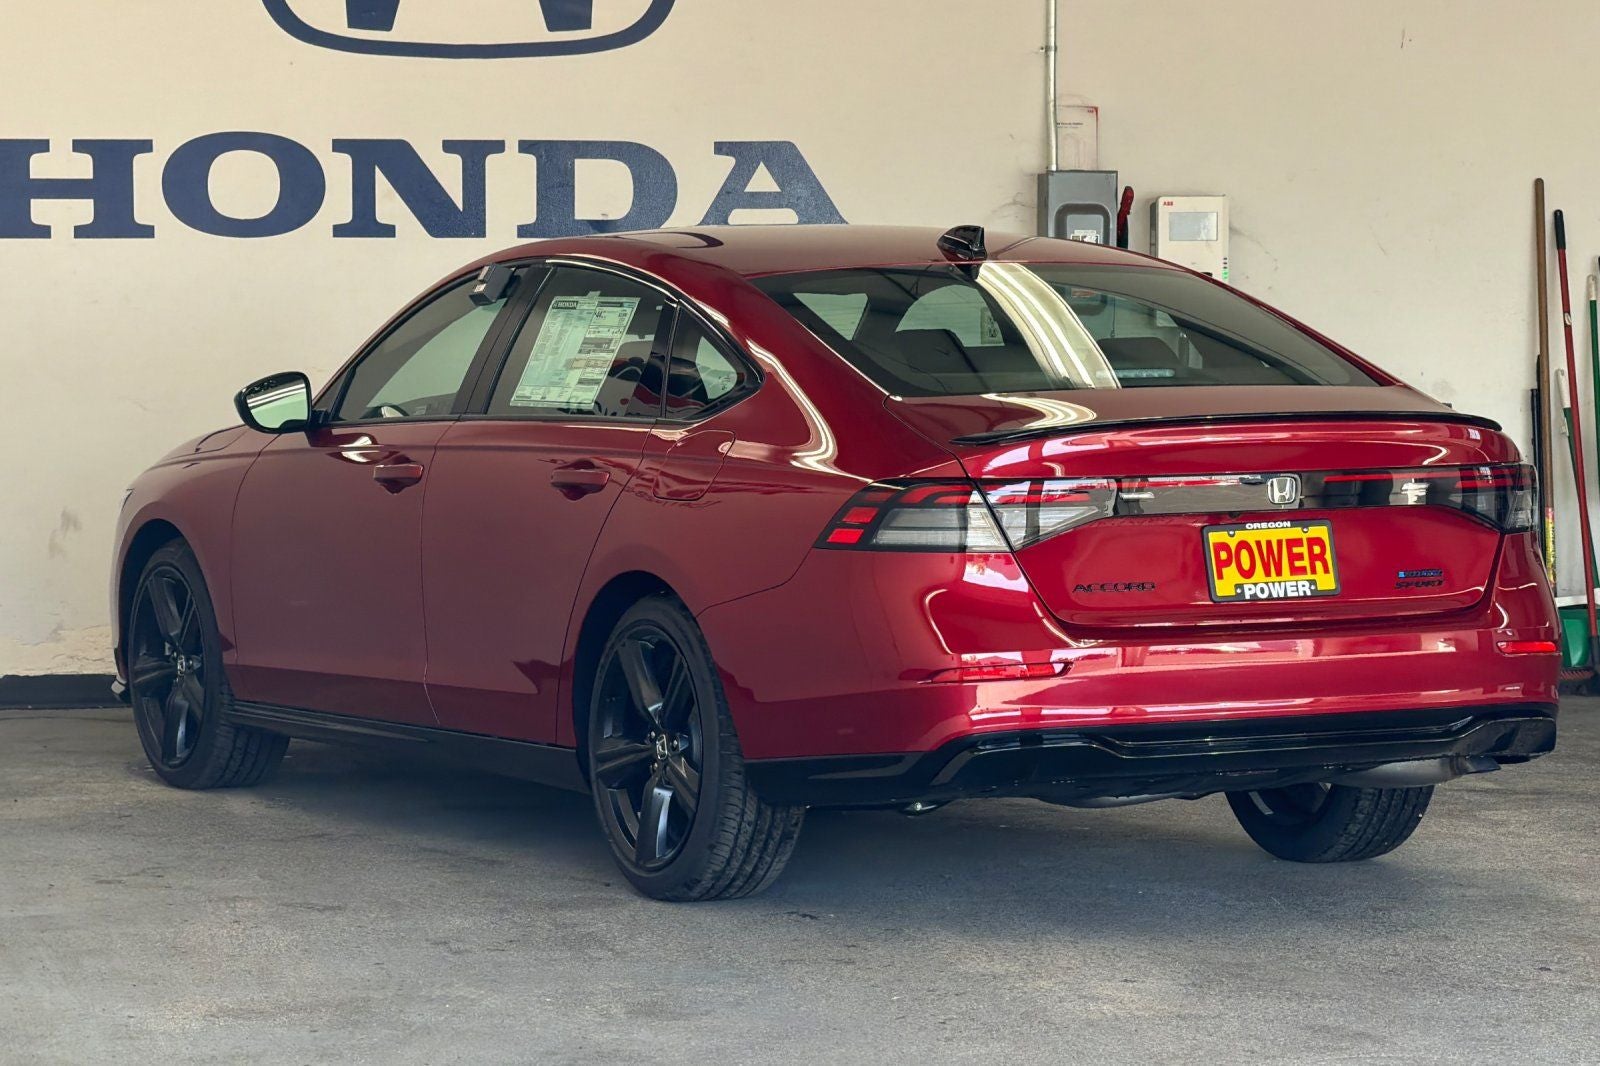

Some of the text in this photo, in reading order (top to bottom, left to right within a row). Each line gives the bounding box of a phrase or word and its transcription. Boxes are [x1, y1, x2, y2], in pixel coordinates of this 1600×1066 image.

[0, 131, 847, 239] HONDA
[1245, 521, 1291, 529] OREGON
[1212, 537, 1330, 580] POWER
[1243, 580, 1312, 599] POWER
